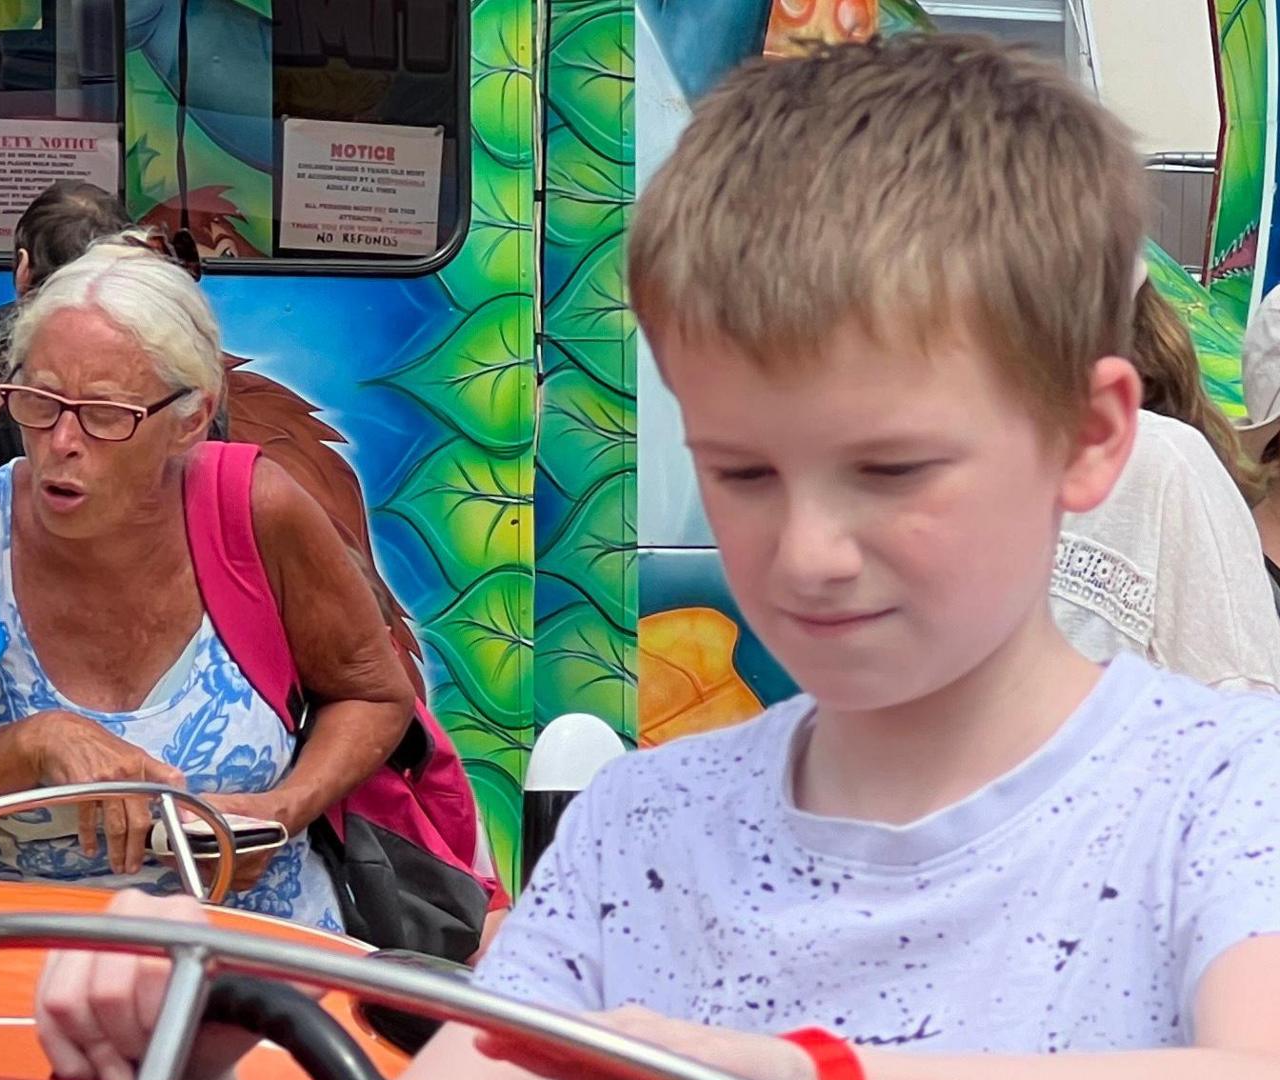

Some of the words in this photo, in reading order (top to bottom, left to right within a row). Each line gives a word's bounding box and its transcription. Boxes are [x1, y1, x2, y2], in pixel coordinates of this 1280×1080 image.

[40, 137, 97, 150] NOTICE
[331, 143, 396, 161] NOTICE
[316, 232, 333, 244] NO
[342, 233, 399, 248] REFUNDS
